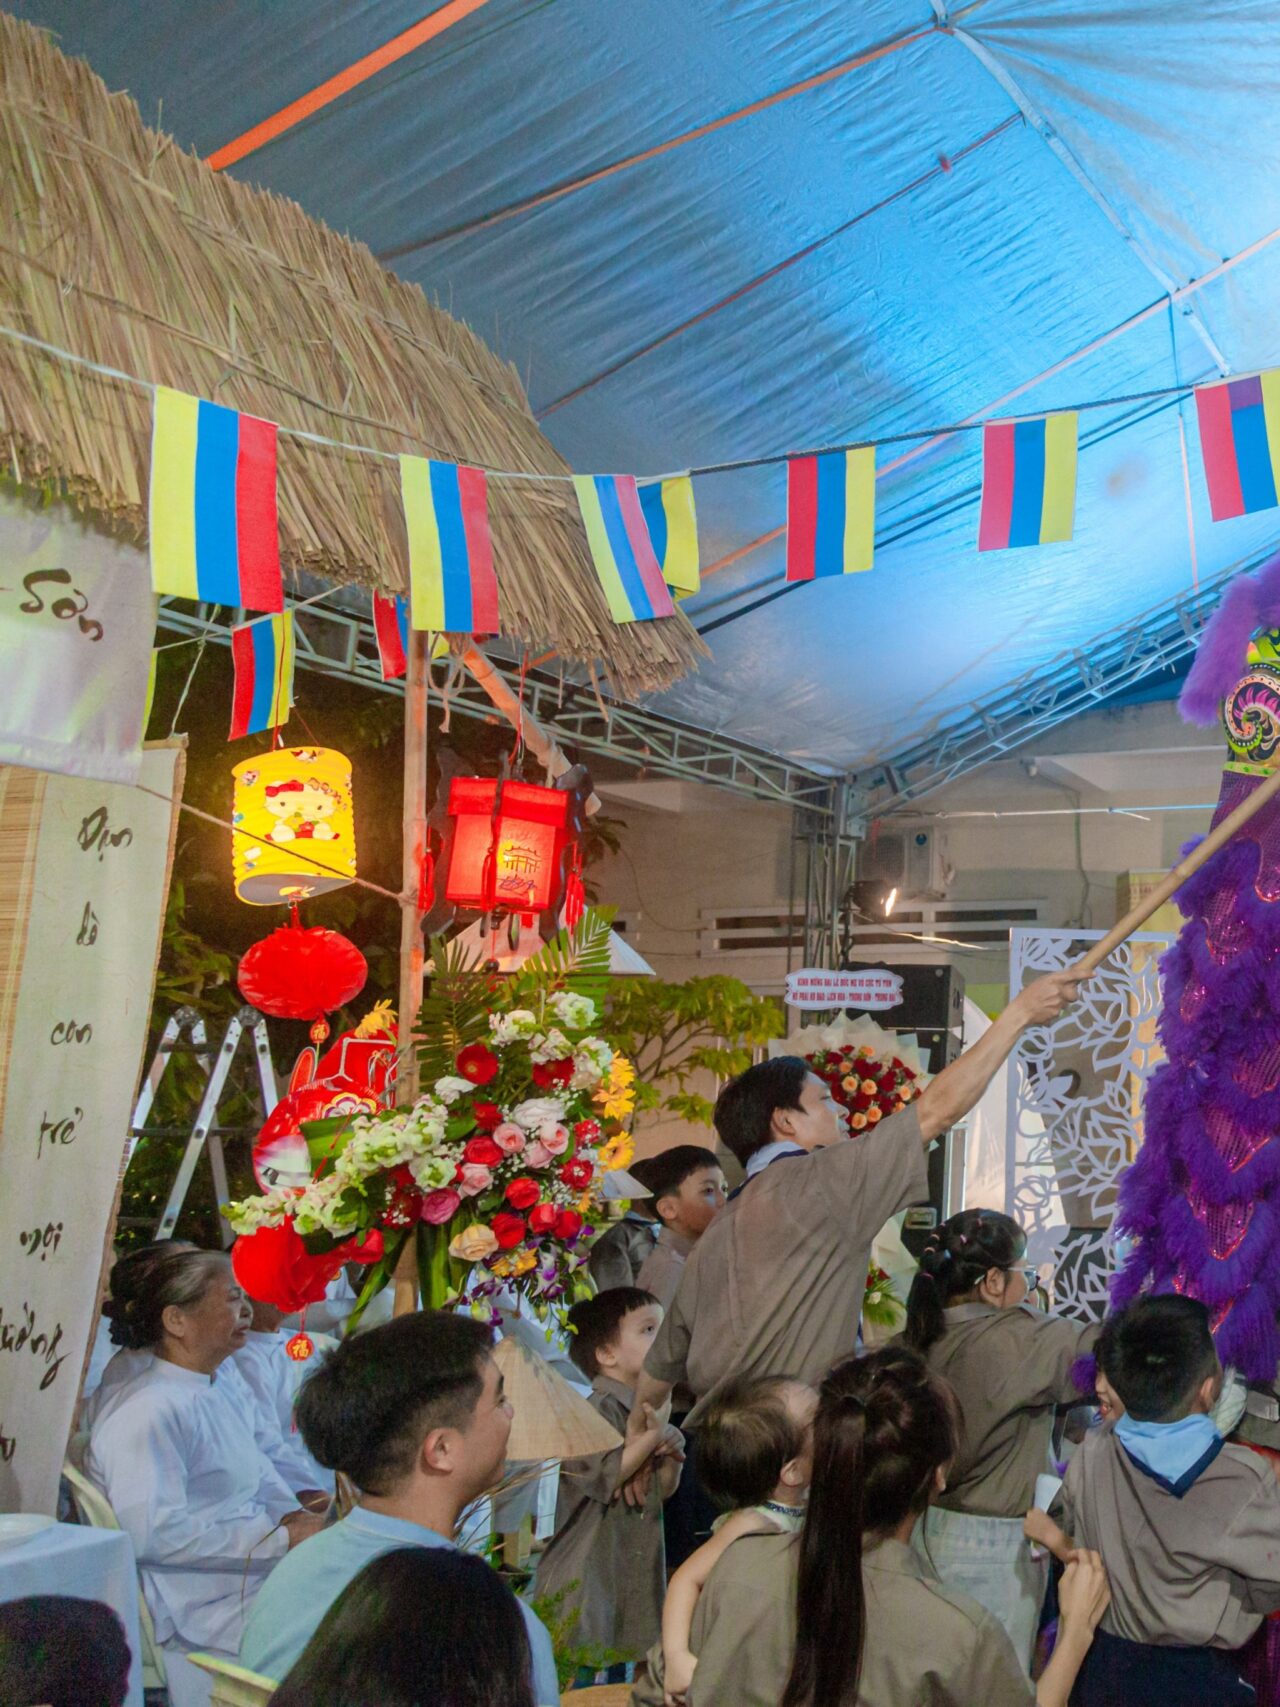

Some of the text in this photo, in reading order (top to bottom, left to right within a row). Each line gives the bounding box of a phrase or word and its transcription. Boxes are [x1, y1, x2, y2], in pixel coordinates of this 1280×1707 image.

[20, 568, 104, 641] Sơn
[37, 1106, 84, 1160] trẻ
[292, 1339, 309, 1358] 福
